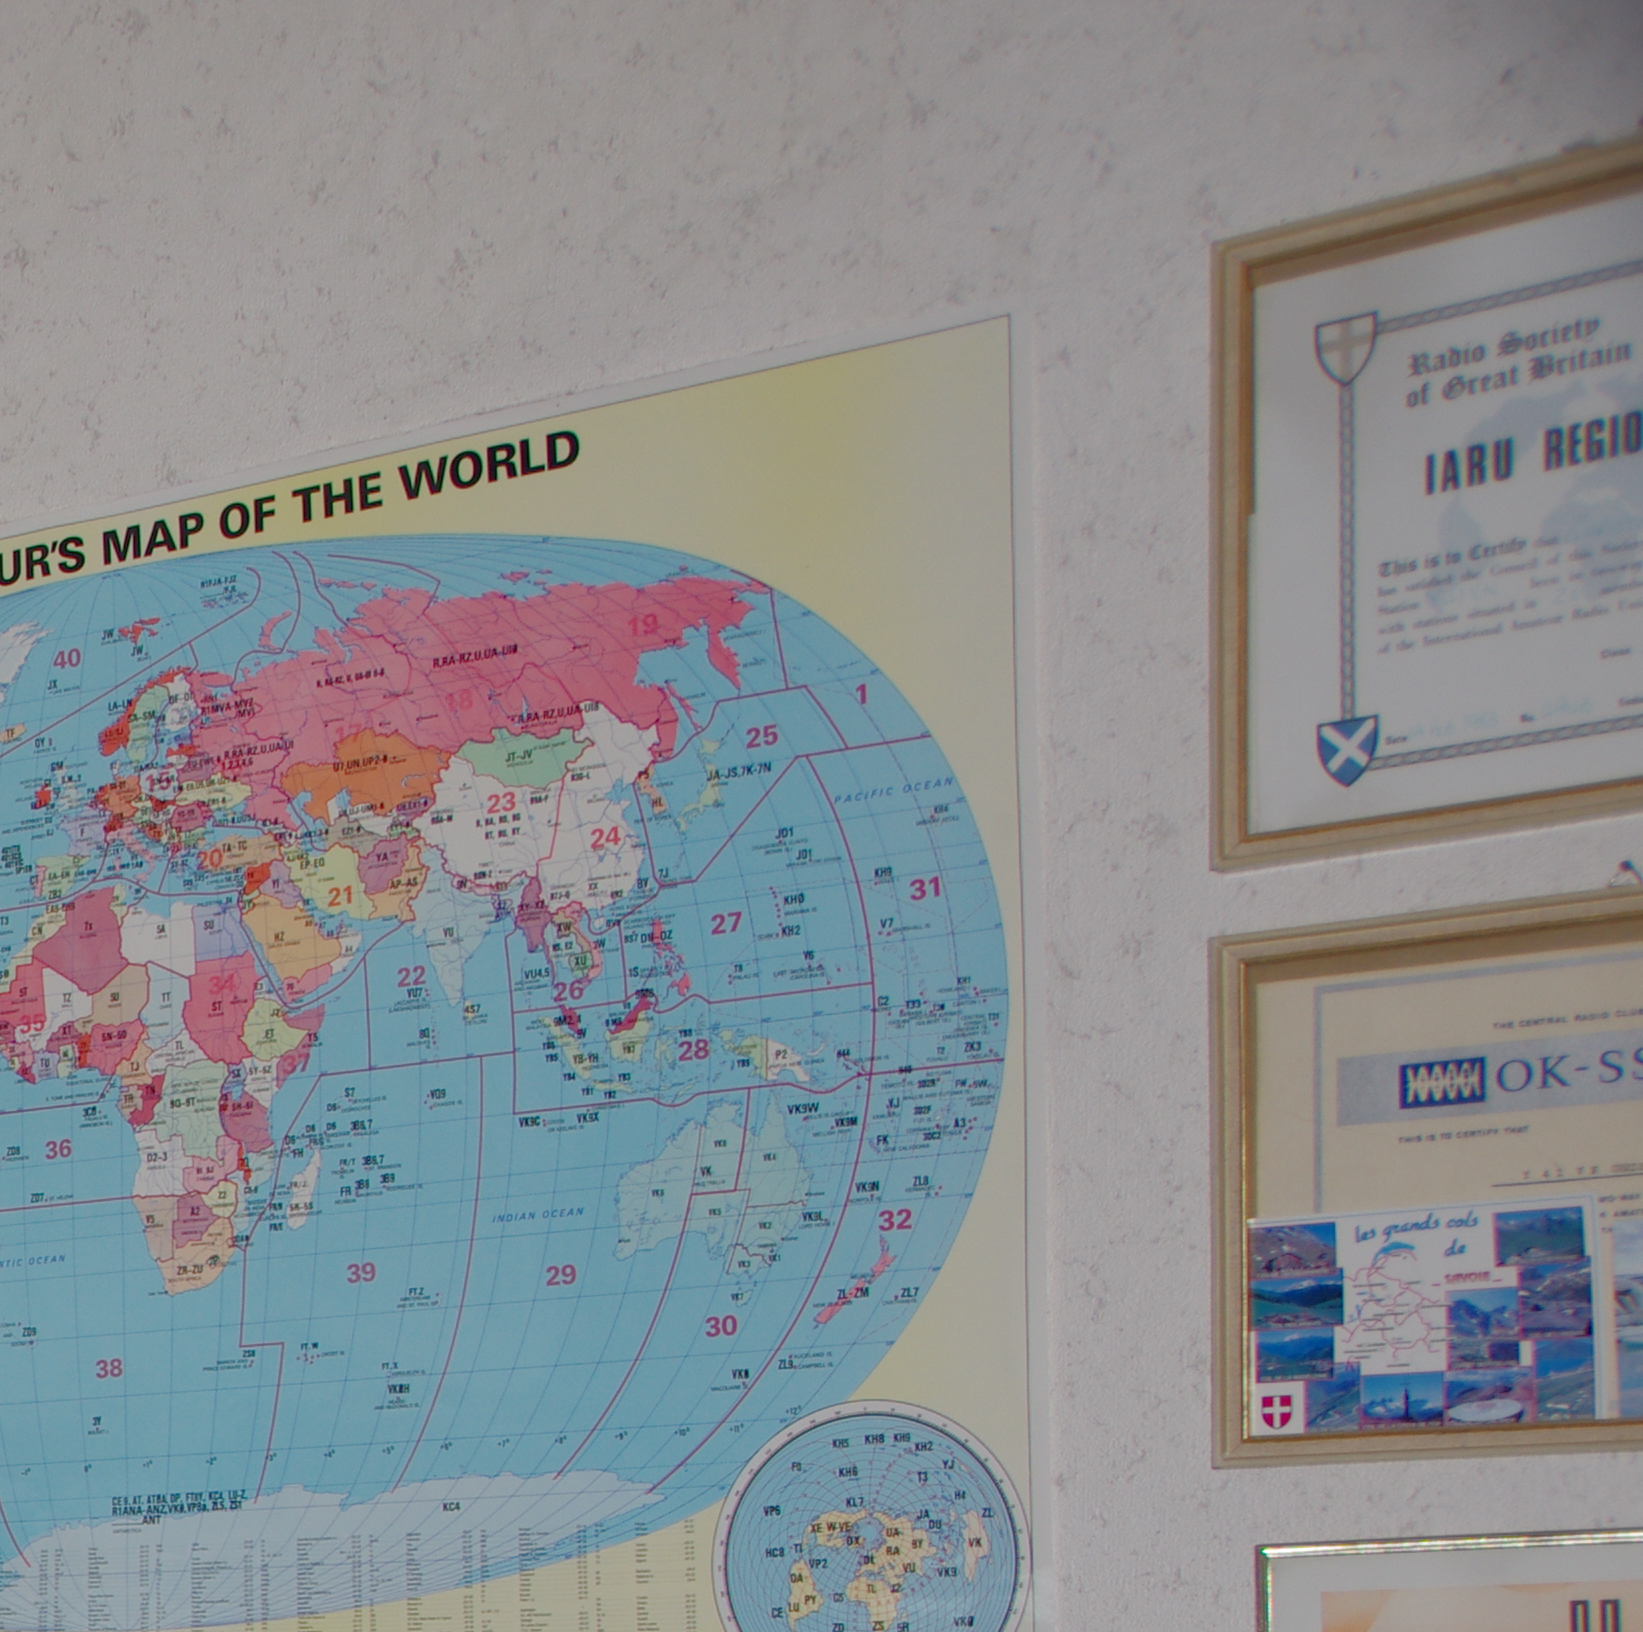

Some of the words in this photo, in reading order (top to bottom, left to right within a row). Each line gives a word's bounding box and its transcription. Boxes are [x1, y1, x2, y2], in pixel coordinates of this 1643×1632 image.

[1407, 344, 1486, 378] Radio
[1496, 318, 1601, 358] Society
[1405, 381, 1430, 409] of
[1441, 366, 1519, 401] Great
[1527, 342, 1633, 385] Britain
[1424, 437, 1515, 496] IARU
[102, 511, 205, 568] MAP
[219, 494, 278, 537] OF
[293, 470, 385, 522] THE
[398, 428, 583, 501] WORLD
[53, 648, 82, 669] 40
[745, 725, 778, 748] 25
[833, 785, 894, 805] PACIFIC
[902, 778, 954, 795] OCEAN
[487, 794, 515, 813] 23
[591, 828, 621, 848] 24
[328, 888, 353, 906] 21
[909, 878, 941, 899] 31
[711, 914, 743, 934] 27
[679, 1040, 710, 1061] 28
[491, 1211, 531, 1223] INDIAN
[537, 1206, 585, 1222] OCEAN
[877, 1208, 913, 1233] 32
[1355, 1225, 1376, 1243] les
[1382, 1212, 1440, 1243] grands
[1446, 1210, 1479, 1229] cols
[1444, 1238, 1467, 1257] de
[346, 1262, 376, 1284] 39
[546, 1264, 577, 1288] 29
[1444, 1271, 1490, 1284] SAVOIE
[706, 1314, 738, 1339] 30
